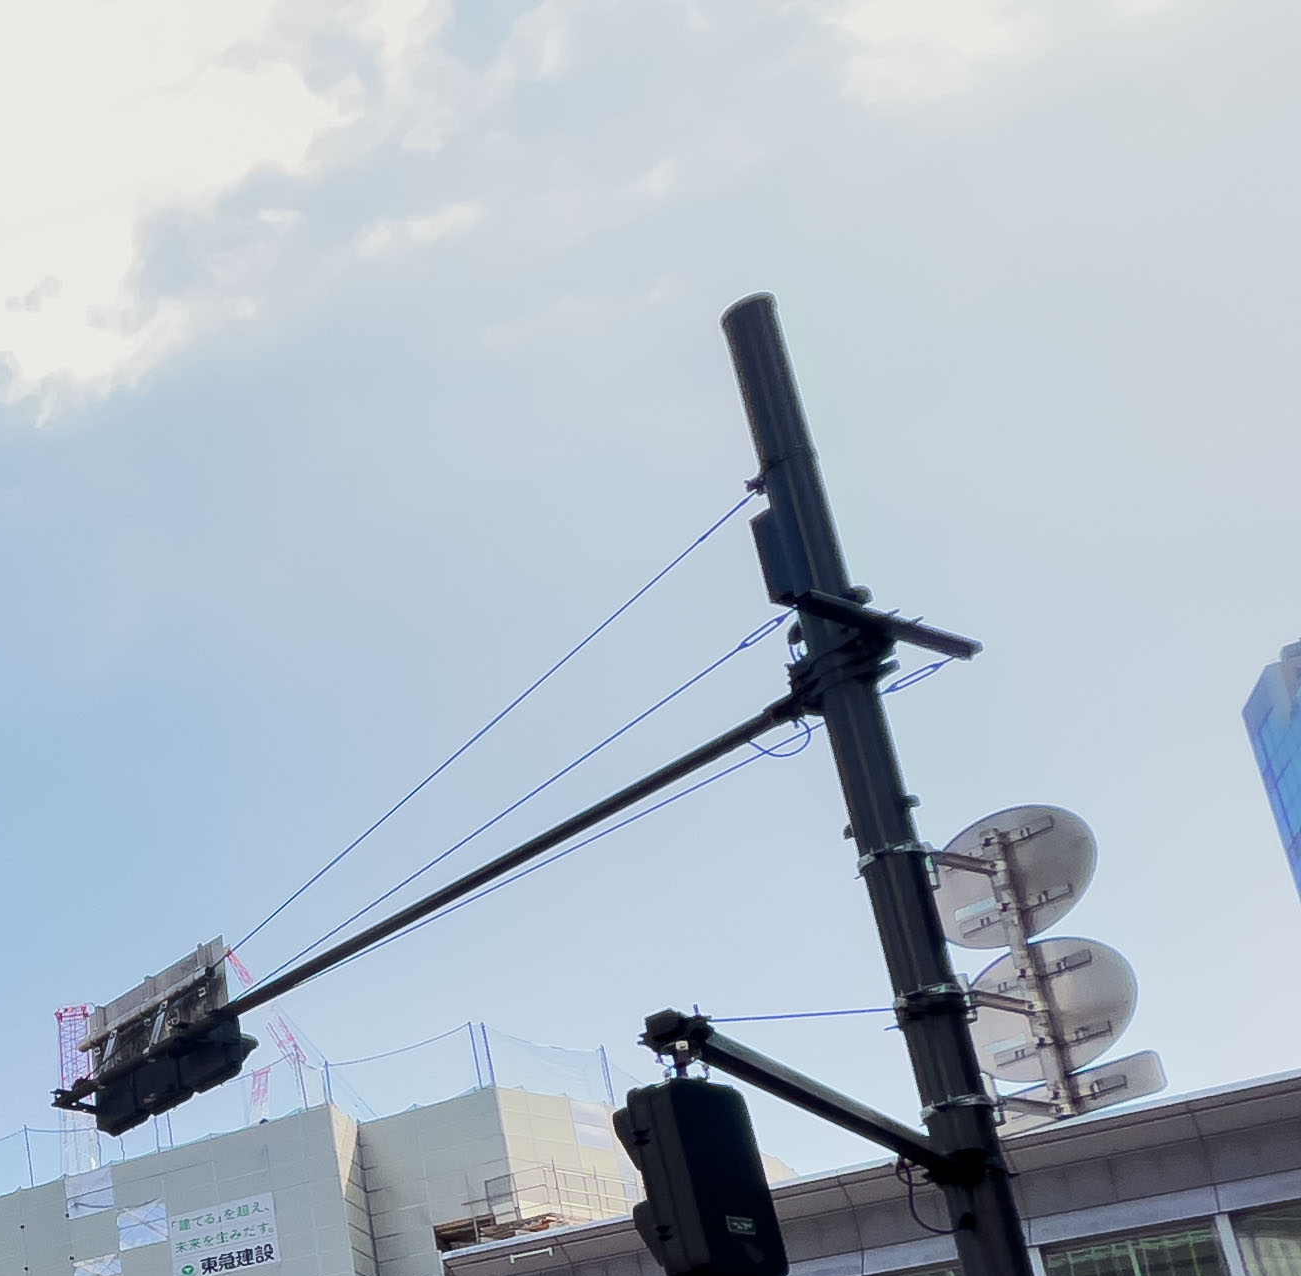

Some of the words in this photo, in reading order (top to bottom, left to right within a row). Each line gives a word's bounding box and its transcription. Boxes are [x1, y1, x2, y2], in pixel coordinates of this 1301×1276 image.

[175, 1222, 275, 1254] 未来を生みだす。
[199, 1243, 275, 1275] 東急建設
